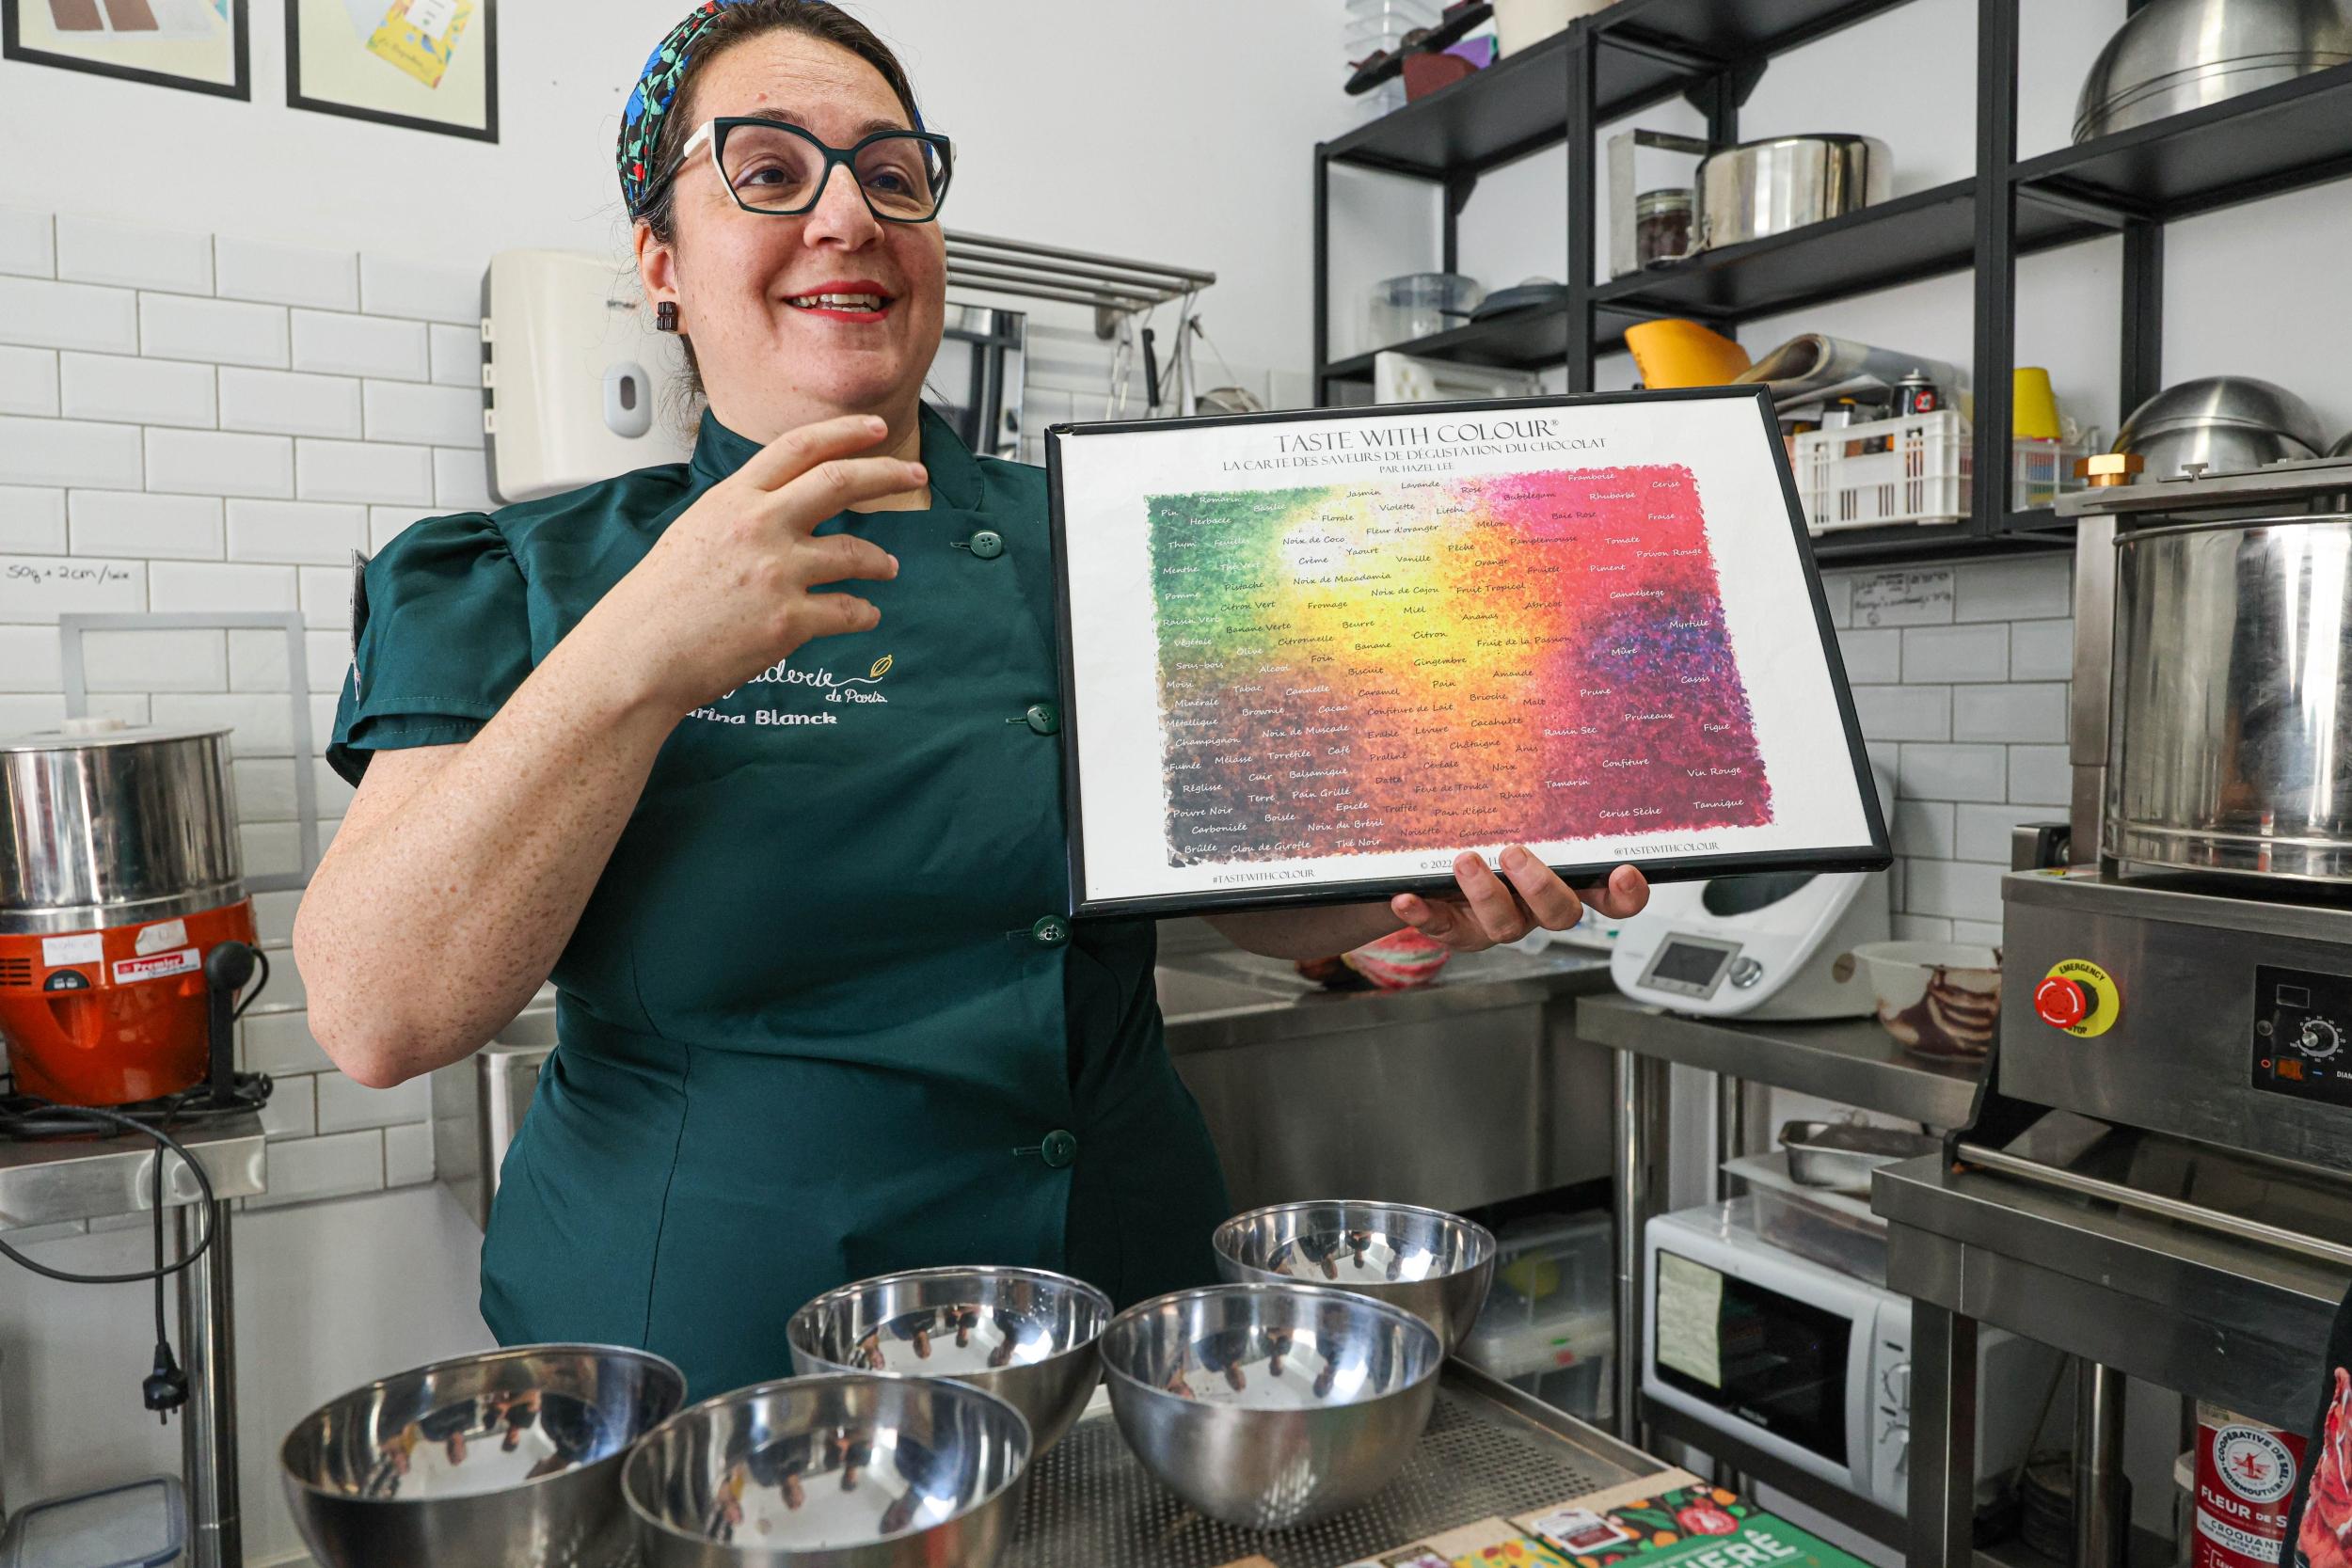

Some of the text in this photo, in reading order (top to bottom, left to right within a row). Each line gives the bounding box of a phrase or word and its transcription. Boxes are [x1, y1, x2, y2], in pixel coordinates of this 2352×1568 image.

[1274, 430, 1353, 453] TASTE
[1359, 427, 1428, 448] WITH
[1224, 437, 1606, 471] LA CARTE DES SAVEURS DE DÉGUSTATION DU CHOCOLAT
[1403, 464, 1435, 472] HAZEL
[1568, 473, 1616, 482] Framboise
[1401, 481, 1440, 489] Lavande
[1504, 492, 1556, 500] Bubblegum
[1589, 492, 1636, 500] Rhubarbe
[1367, 525, 1438, 535] Fleur d'oranger
[1511, 536, 1578, 546] Pamplemousse
[1604, 536, 1641, 545] Tomate
[1346, 547, 1378, 556] Yaourt
[1475, 559, 1509, 567] Orange
[1590, 564, 1626, 573] Piment
[1335, 574, 1391, 583] Macadamia
[1225, 582, 1263, 592] Pistache
[1413, 586, 1438, 594] Cajou
[1485, 582, 1526, 593] Tropical
[1611, 590, 1665, 599] Canneberge
[1524, 600, 1562, 610] Abricot
[1226, 622, 1291, 634] Banane Verte
[1343, 620, 1375, 629] Beurre
[1670, 619, 1711, 628] Myrtille
[1278, 635, 1334, 646] Citronnelle
[1477, 639, 1502, 647] Fruit
[1534, 636, 1571, 644] Passion
[1356, 641, 1391, 650] Banane
[1236, 647, 1263, 656] Olive
[1414, 657, 1467, 666] Gingembre
[1259, 664, 1290, 673] Alcool
[1348, 667, 1384, 675] Biscuit
[1493, 670, 1534, 678] Amande
[1681, 675, 1710, 684] Cassis
[1433, 680, 1456, 689] Pain
[1286, 686, 1330, 696] Cannelle
[1359, 689, 1400, 697] Caramel
[1581, 689, 1613, 698] Prune
[1242, 707, 1284, 716] Brownie
[1319, 705, 1348, 714] Cacao
[1367, 706, 1413, 716] Confiture
[1417, 704, 1429, 712] de
[755, 709, 837, 725] Blanck
[1625, 713, 1675, 721] Pruneaux
[1291, 727, 1302, 736] de
[1306, 725, 1349, 735] Muscade
[1545, 728, 1578, 736] Raisin
[1704, 723, 1731, 733] Figue
[1176, 737, 1240, 747] Champignon
[1328, 746, 1350, 755] Café
[1602, 758, 1649, 768] Confiture
[1290, 768, 1348, 779] Balsamique
[1687, 767, 1741, 778] Vin Rouge
[1545, 778, 1590, 788] Tamarin
[1293, 787, 1352, 799] Pain Grillé
[1248, 794, 1275, 802] Terre
[1693, 799, 1744, 810] Tannique
[1173, 810, 1206, 818] Poivre
[1599, 806, 1662, 818] Cerise Sèche
[1401, 828, 1440, 836] Noisette
[1459, 827, 1520, 838] Cardamome
[1231, 841, 1311, 853] Clou de Girofle
[1614, 842, 1721, 856] @TASTEWITHCOLOUR
[1213, 869, 1316, 883] #TASTEWITHCOLOUR
[2059, 963, 2106, 981] EMERGENCY
[2201, 1485, 2250, 1519] FLEUR
[2256, 1513, 2271, 1523] DE
